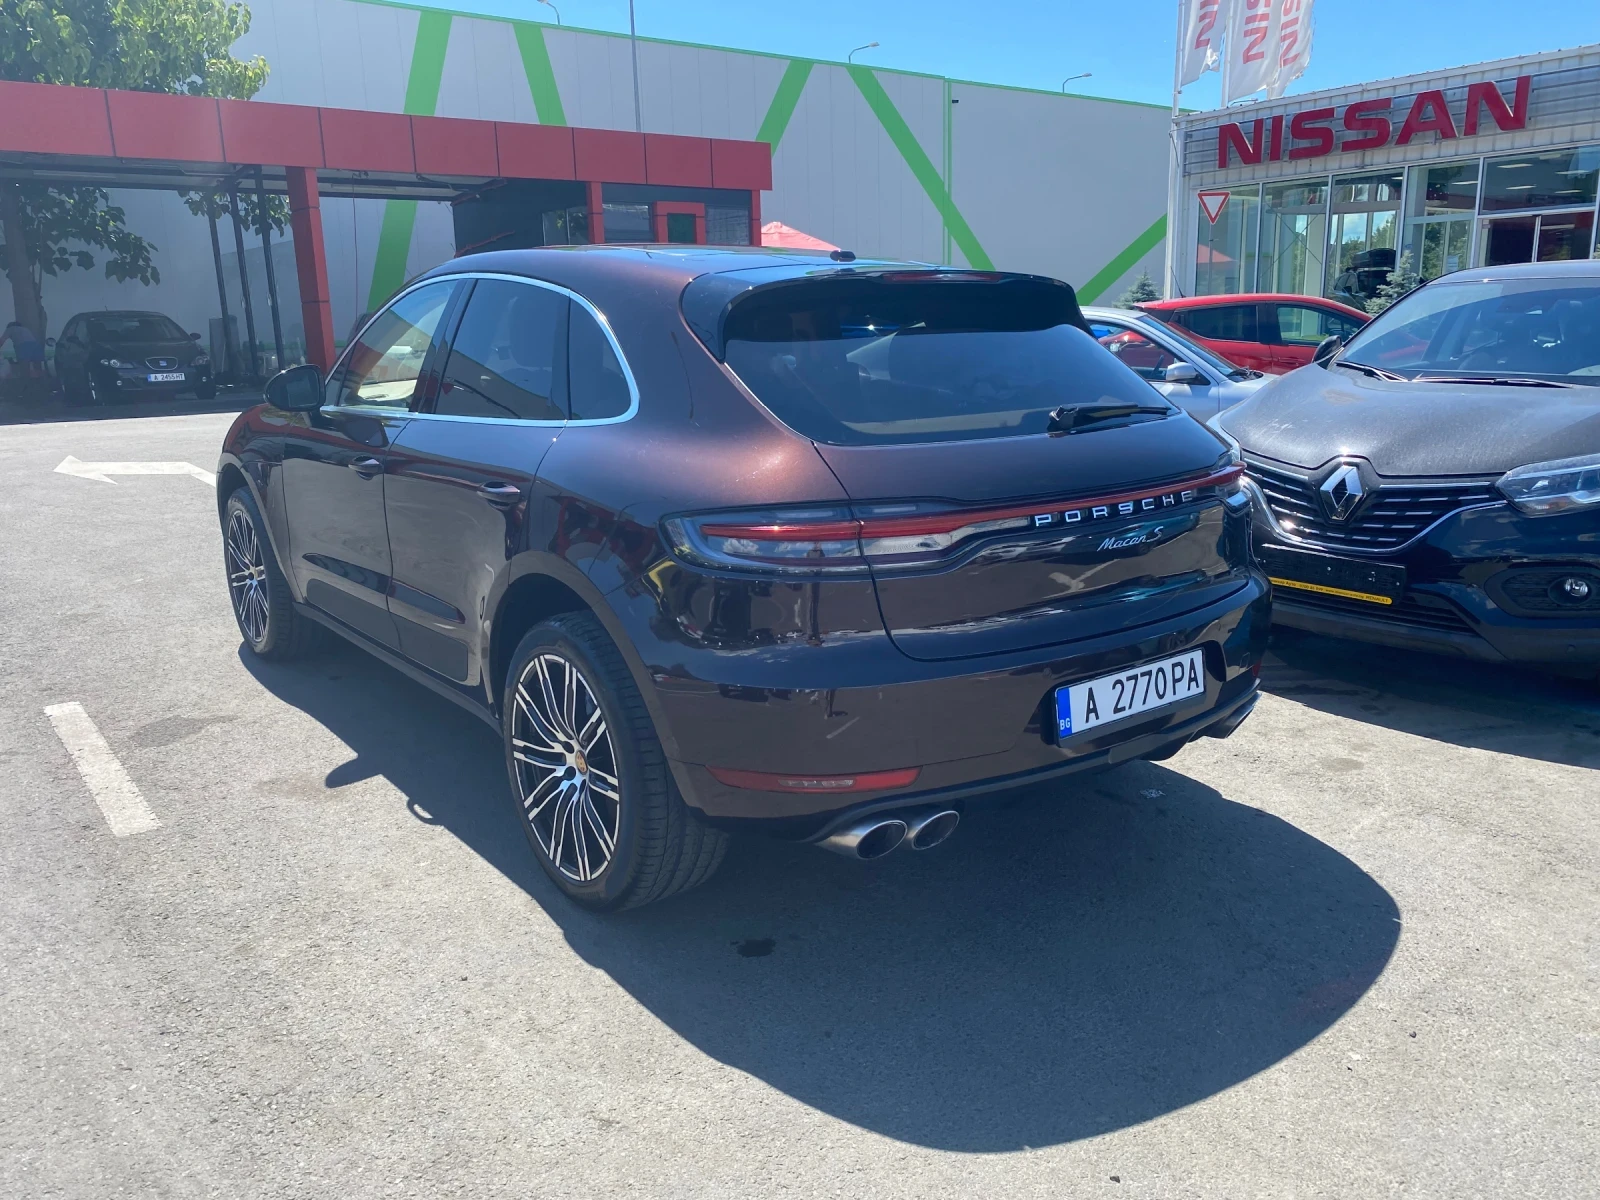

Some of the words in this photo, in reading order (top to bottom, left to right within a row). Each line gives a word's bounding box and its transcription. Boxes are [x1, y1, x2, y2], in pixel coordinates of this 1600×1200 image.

[1217, 75, 1532, 169] NISSAN
[1035, 490, 1193, 526] PORSCHE
[1097, 535, 1147, 551] Macan
[1147, 526, 1164, 543] S
[1085, 687, 1099, 723] A
[1112, 657, 1200, 714] 2770PA
[1060, 718, 1071, 730] BG
